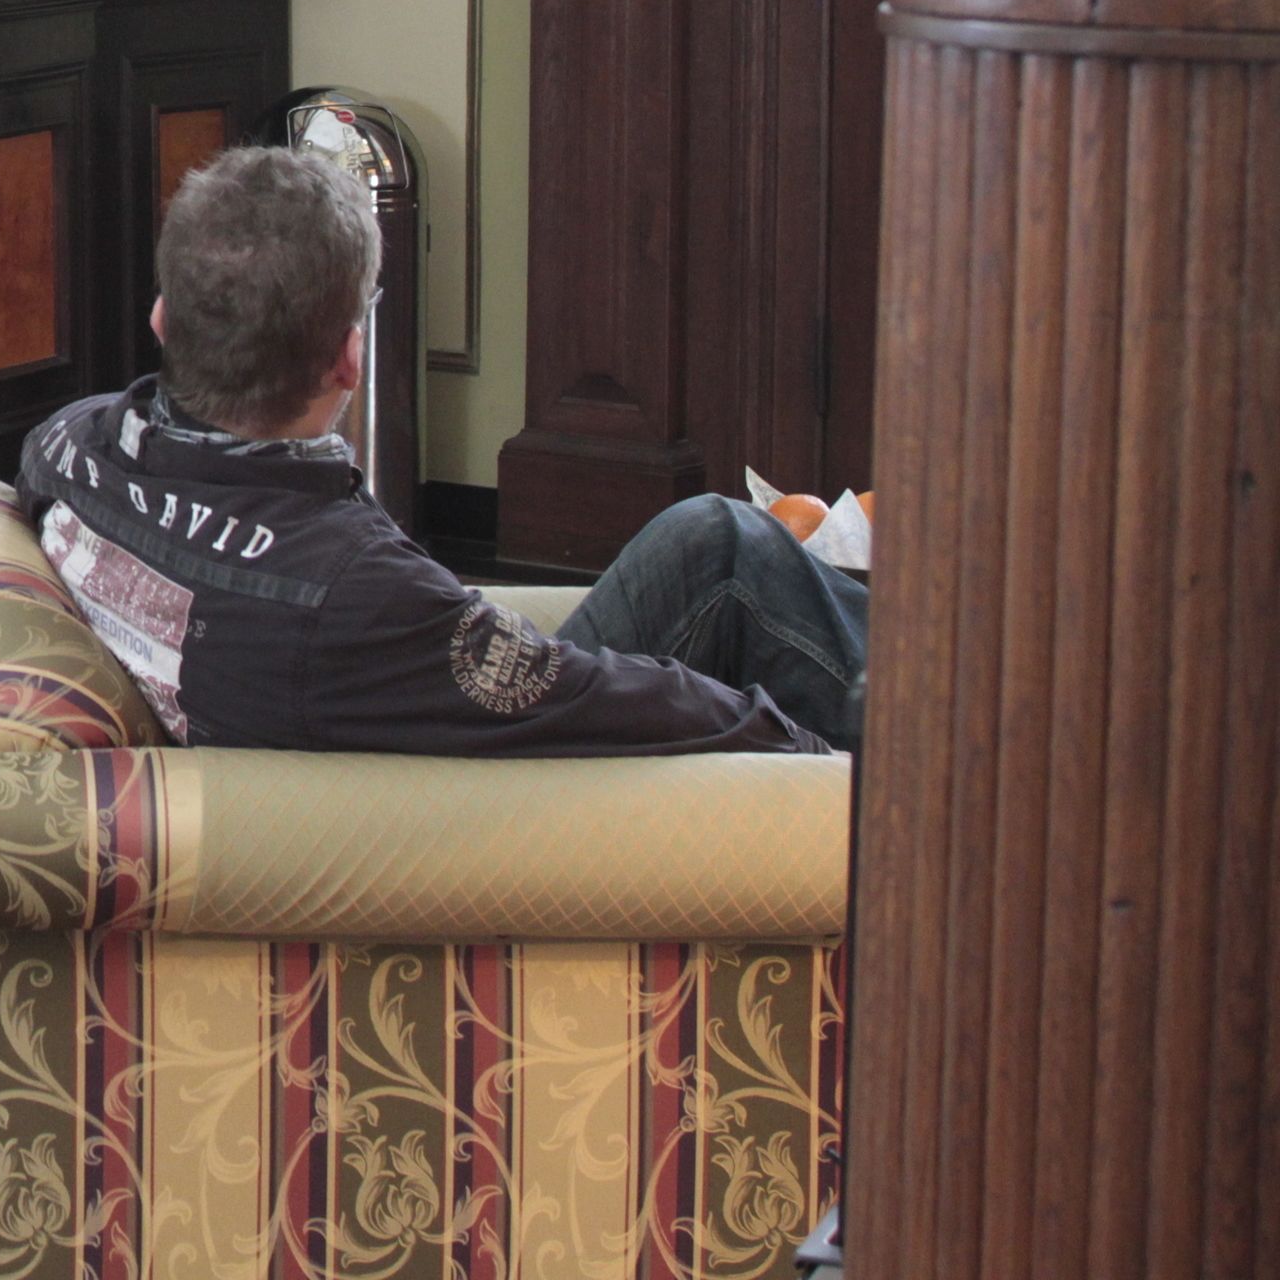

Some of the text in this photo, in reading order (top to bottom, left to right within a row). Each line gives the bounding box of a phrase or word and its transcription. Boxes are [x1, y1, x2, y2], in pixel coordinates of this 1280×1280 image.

[40, 419, 275, 559] CAMP DAVID
[449, 649, 513, 714] WILDERNESS
[477, 634, 507, 689] CAMP
